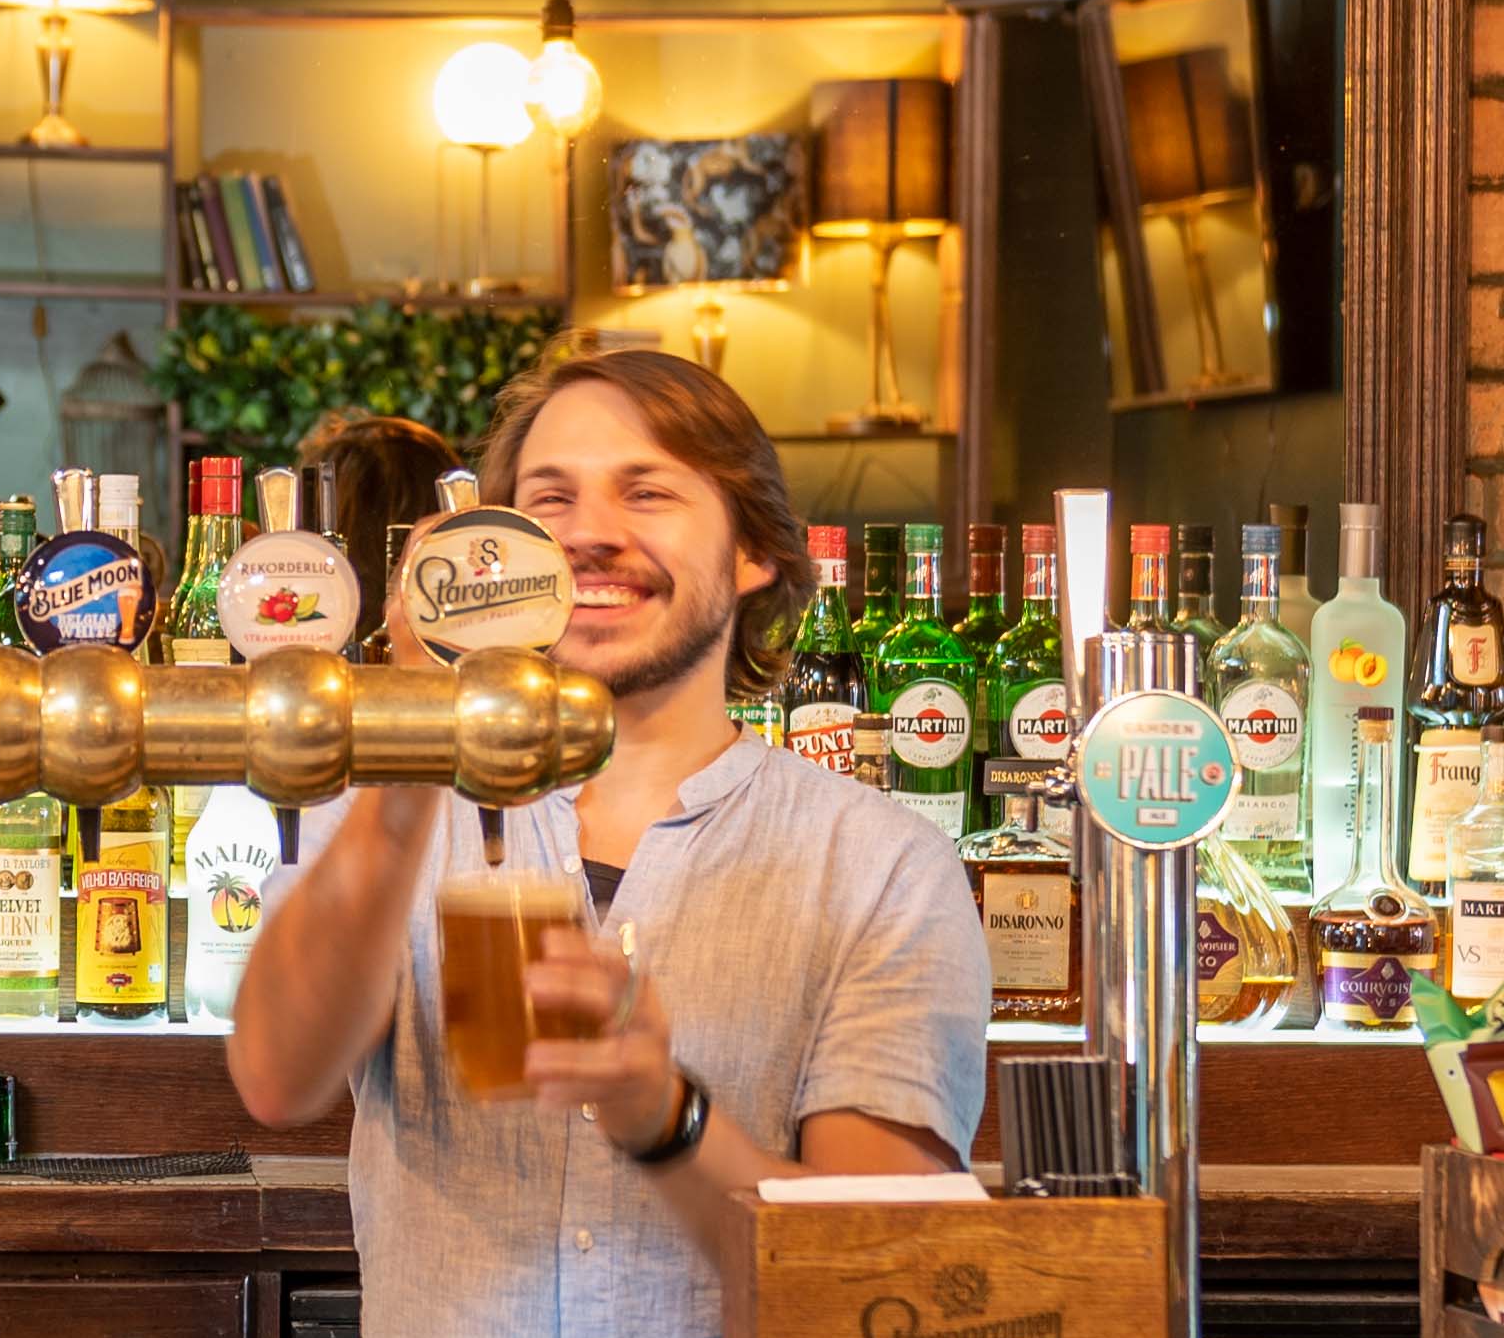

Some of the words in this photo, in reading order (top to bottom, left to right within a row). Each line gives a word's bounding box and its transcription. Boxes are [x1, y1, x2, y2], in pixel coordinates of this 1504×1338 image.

[240, 561, 336, 576] REKORDERLIG
[32, 581, 84, 618] BLUE
[88, 564, 139, 595] MOON
[415, 556, 562, 624] Staropramen
[742, 709, 778, 720] NEPHW
[896, 718, 963, 734] MARTINI
[1020, 719, 1069, 735] MARTI
[1228, 719, 1296, 734] MARTINI
[791, 727, 853, 756] PUNT
[990, 769, 1048, 784] DISARONN
[1118, 744, 1198, 802] PALE
[1428, 752, 1481, 786] Frang
[938, 799, 959, 807] DRY
[1238, 800, 1287, 809] BIANCO
[1, 914, 54, 937] ERNUM
[989, 914, 1064, 931] DISARONNO
[1197, 940, 1236, 953] VOISIER
[1457, 944, 1481, 964] VS
[1339, 979, 1413, 999] COURVOIS
